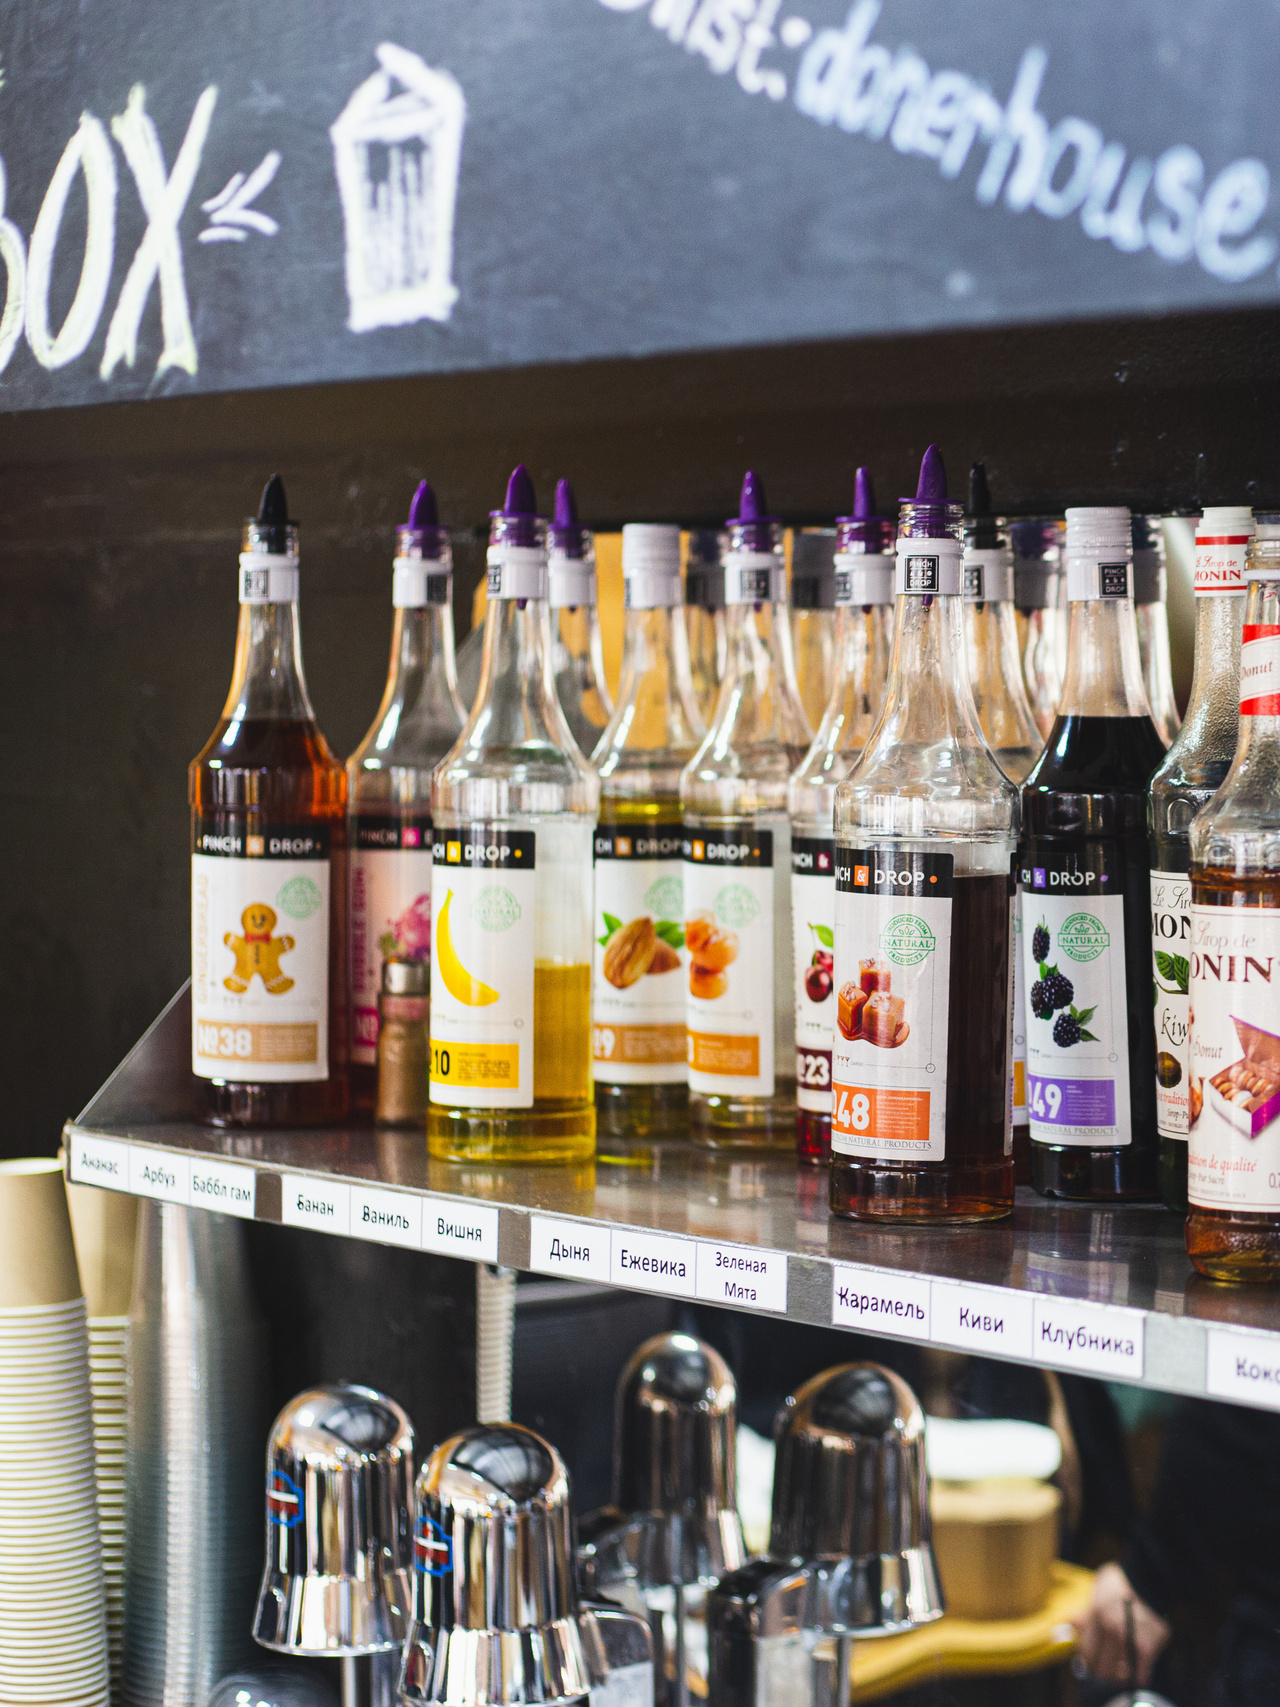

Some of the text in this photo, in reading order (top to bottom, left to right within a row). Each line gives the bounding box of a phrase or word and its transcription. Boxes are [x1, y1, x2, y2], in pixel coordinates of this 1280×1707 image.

[909, 580, 932, 588] DROP
[202, 834, 242, 853] PINCH
[269, 838, 314, 855] DROP
[464, 844, 511, 861] DROP
[706, 843, 750, 860] DROP
[874, 869, 926, 886] DROP
[1049, 871, 1096, 886] DROP
[884, 938, 931, 948] NATURAL
[1062, 936, 1106, 945] NATURAL
[1233, 933, 1256, 949] de
[1074, 1127, 1119, 1135] PRODUCTS
[848, 1136, 881, 1146] NATURAL
[884, 1139, 932, 1149] PRODUCTS
[81, 1152, 119, 1175] Ананас
[142, 1165, 176, 1187] Арбуз
[192, 1175, 252, 1202] Баббл гам
[296, 1194, 335, 1217] Банан
[361, 1205, 411, 1230] Ваниль
[436, 1217, 483, 1242] Вишня
[549, 1238, 591, 1262] Дыня
[620, 1249, 687, 1278] Ежевика
[714, 1251, 768, 1275] Зеленая
[724, 1281, 757, 1301] Мята
[835, 1286, 926, 1320] Карамель
[958, 1306, 1005, 1334] Киви
[1041, 1320, 1136, 1357] Клубника
